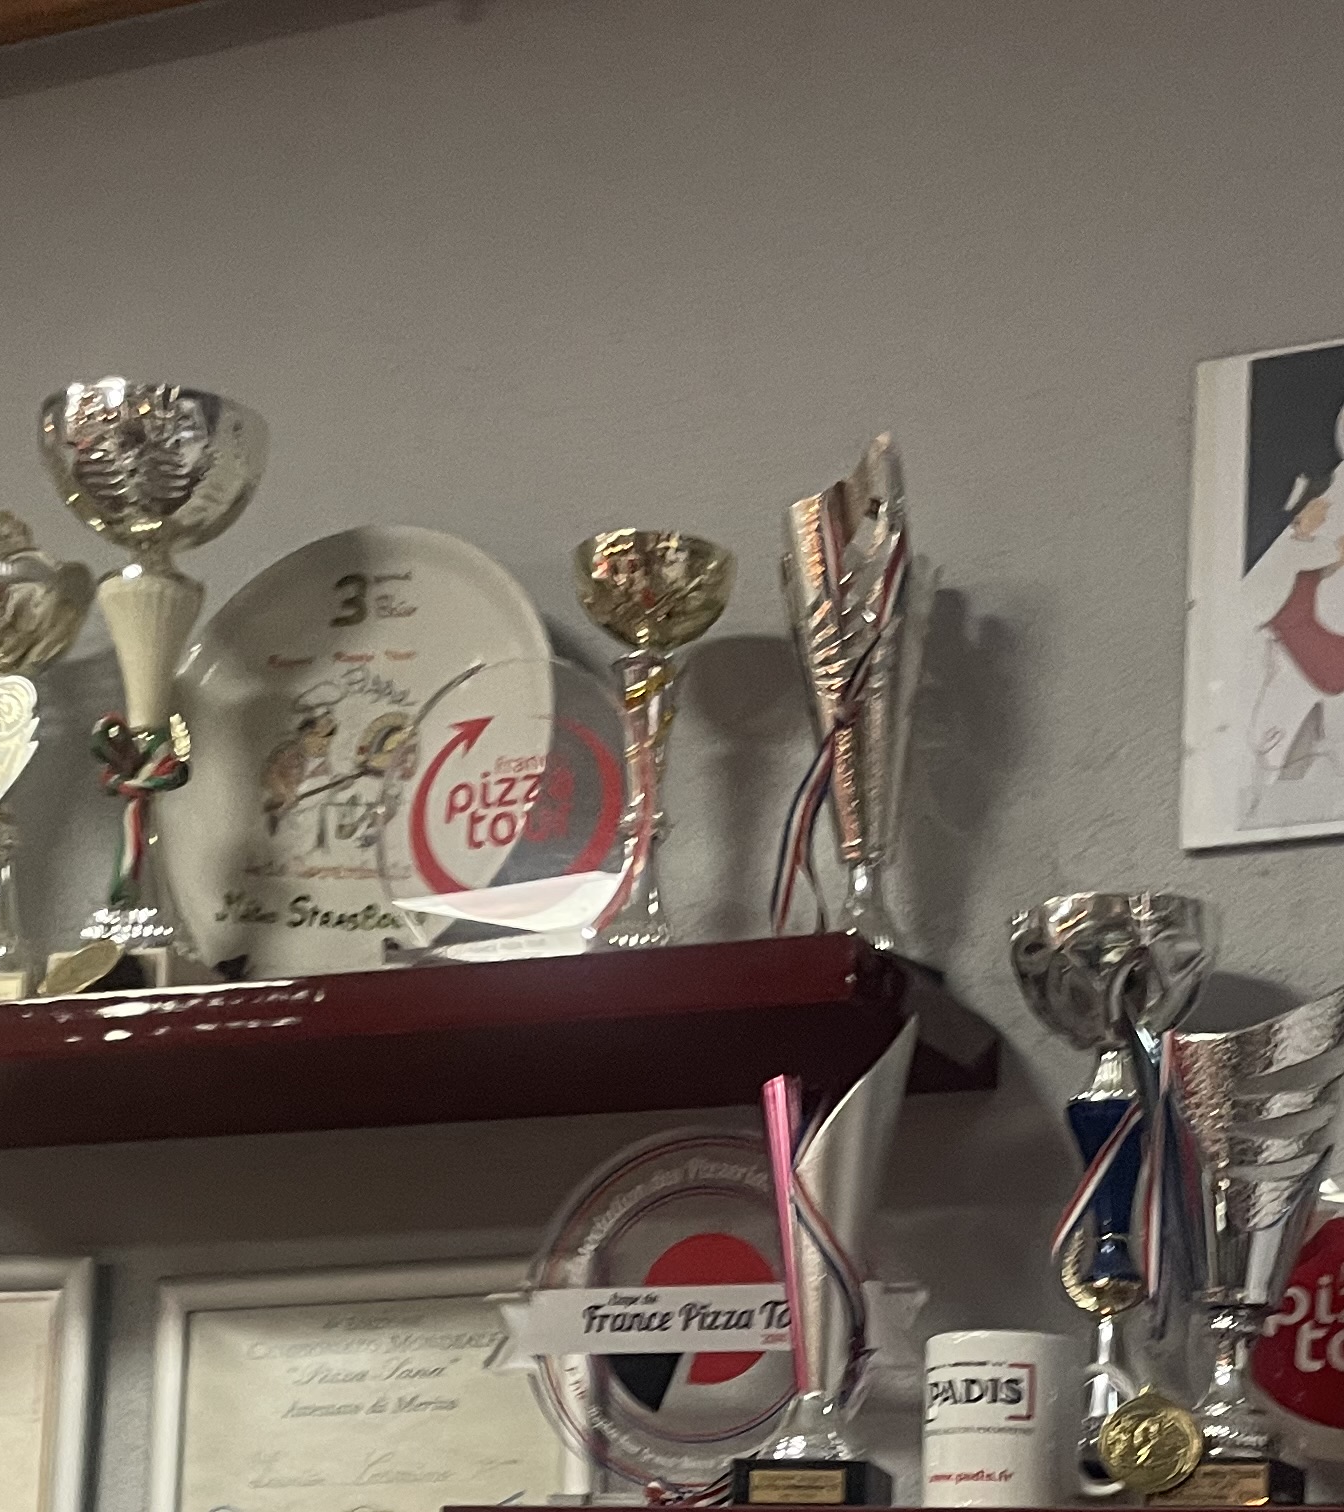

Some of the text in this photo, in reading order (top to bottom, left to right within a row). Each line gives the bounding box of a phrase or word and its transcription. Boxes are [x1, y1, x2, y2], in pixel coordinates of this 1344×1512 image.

[582, 1299, 793, 1335] France Pizza To
